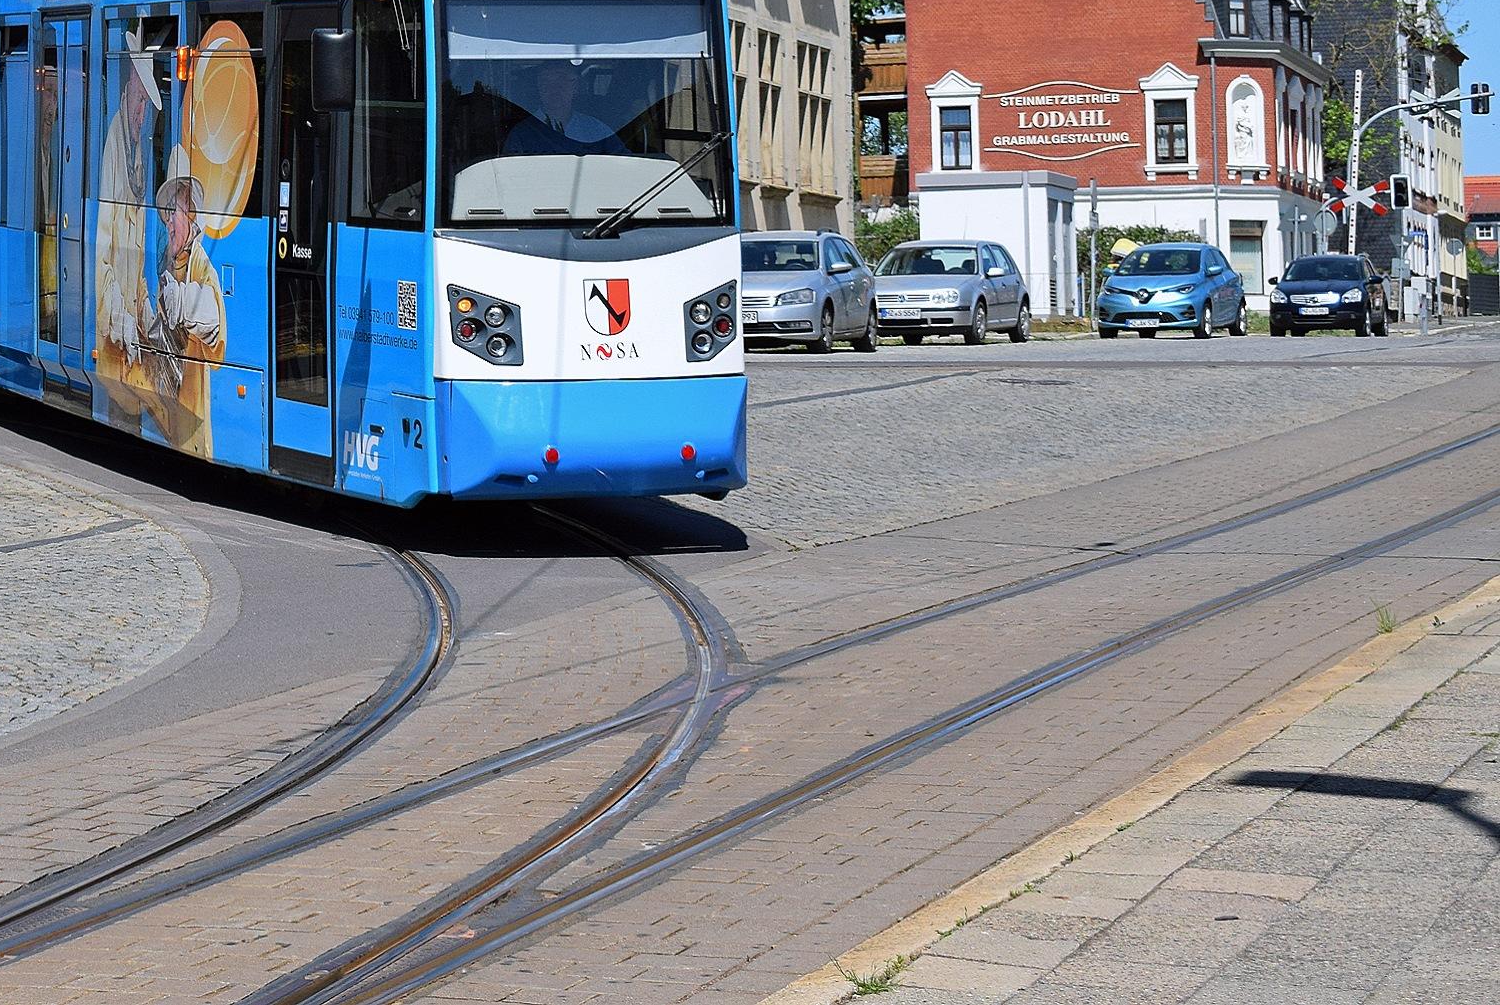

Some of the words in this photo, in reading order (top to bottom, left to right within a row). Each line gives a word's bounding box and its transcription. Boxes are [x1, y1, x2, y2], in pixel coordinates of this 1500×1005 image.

[1000, 93, 1121, 107] STEINMETZBETRIEB
[1017, 109, 1111, 129] LODAHL
[992, 132, 1130, 146] GRABMALGESTALTUNG
[292, 243, 312, 259] Kasse
[343, 430, 380, 471] HVG
